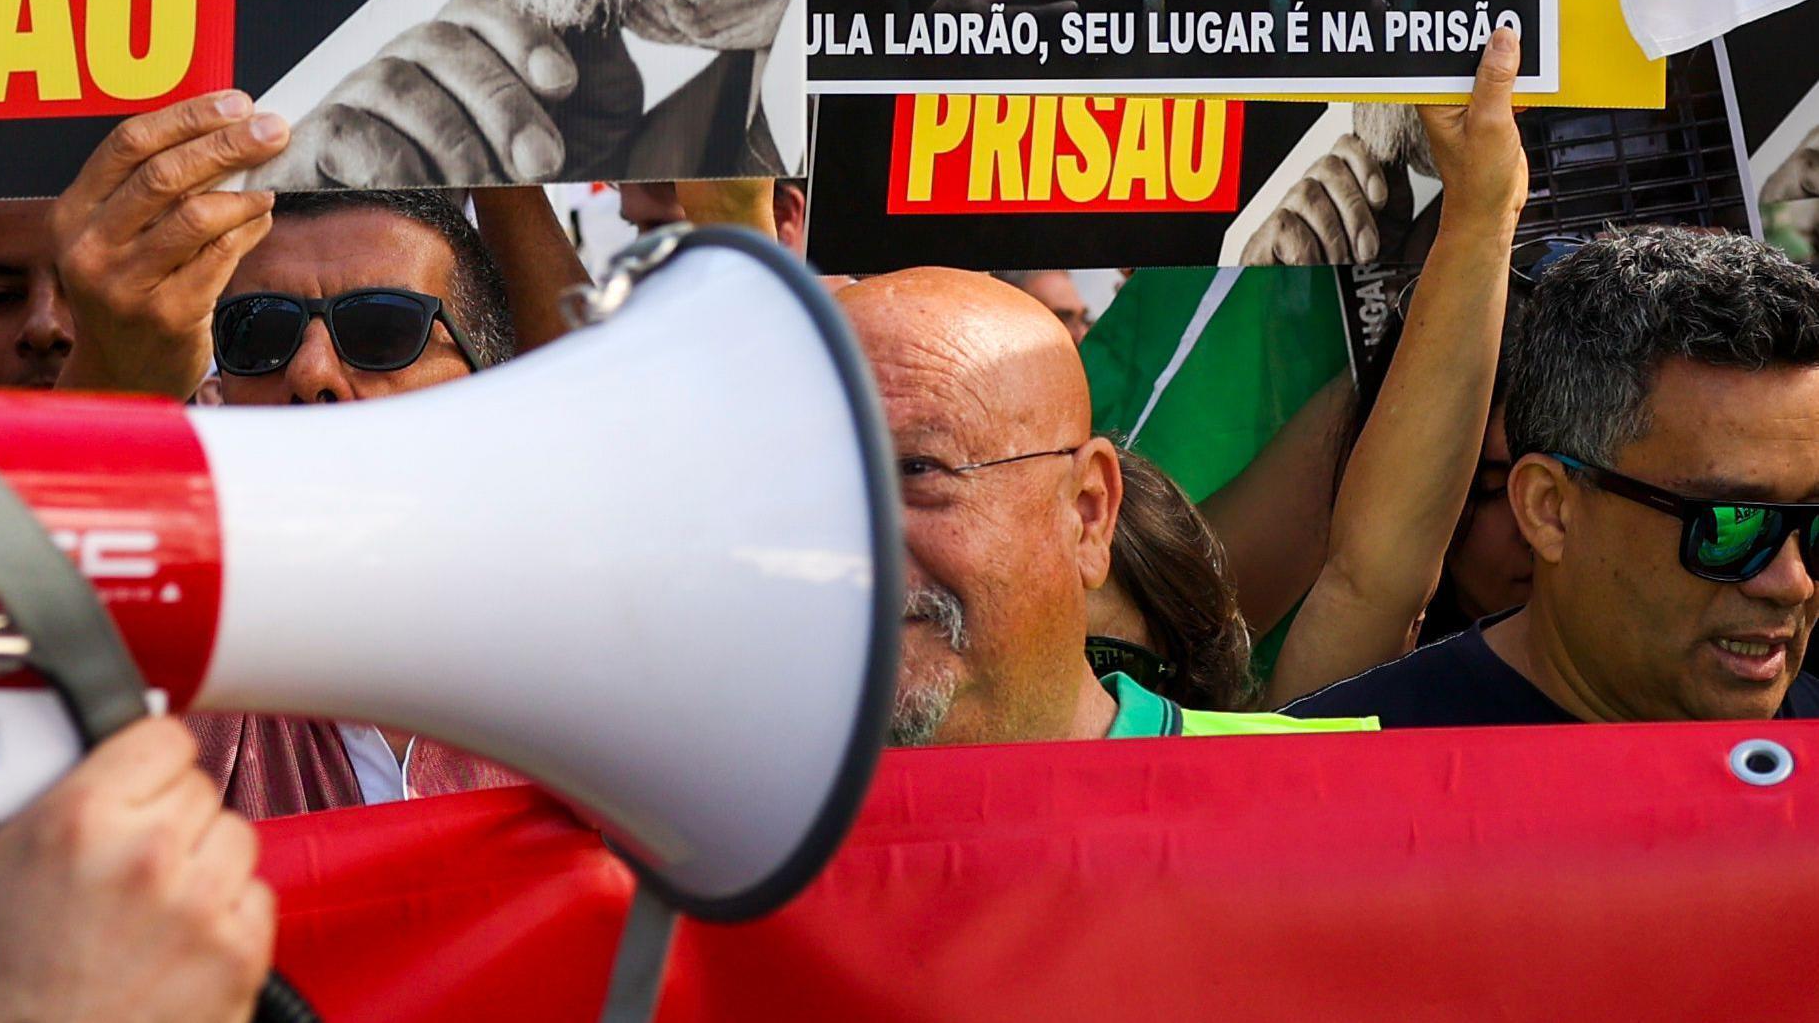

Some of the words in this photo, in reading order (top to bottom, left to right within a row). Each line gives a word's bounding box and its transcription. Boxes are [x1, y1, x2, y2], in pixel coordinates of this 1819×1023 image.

[885, 3, 1049, 65] LADRÃO,
[1060, 12, 1134, 54] SEU
[1148, 11, 1275, 54] LUGAR
[1287, 1, 1309, 53] É
[1322, 11, 1374, 52] NA
